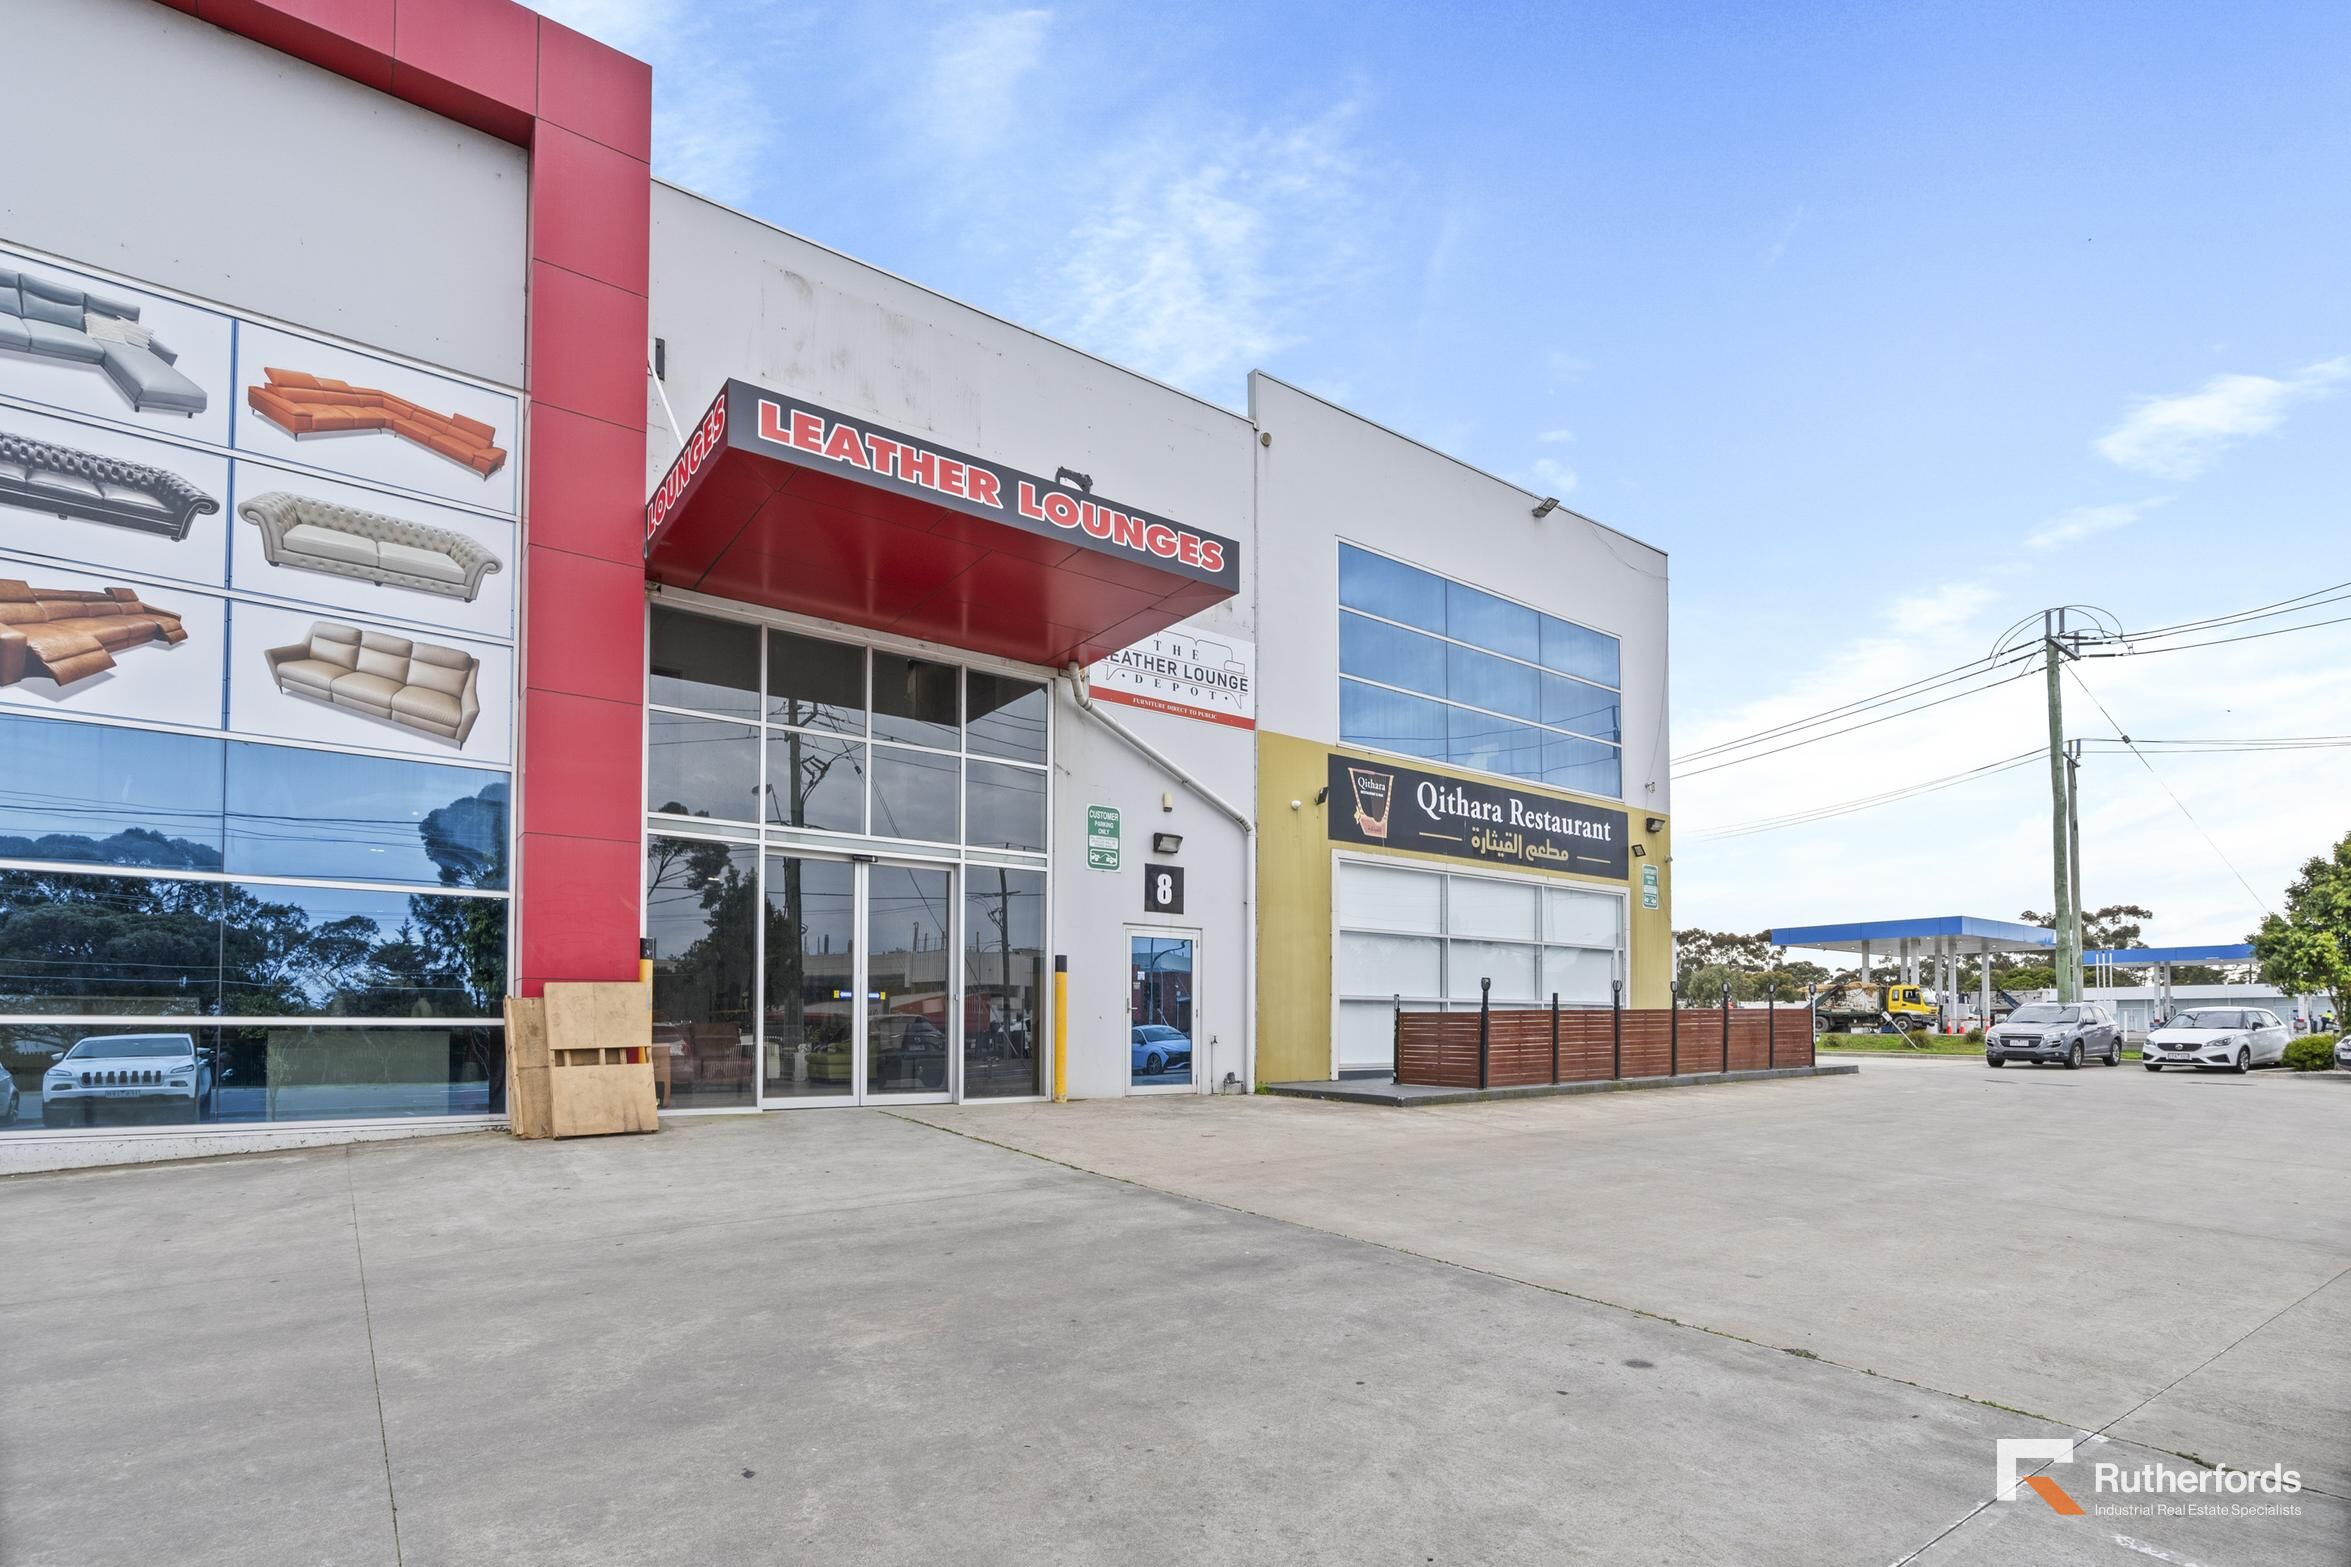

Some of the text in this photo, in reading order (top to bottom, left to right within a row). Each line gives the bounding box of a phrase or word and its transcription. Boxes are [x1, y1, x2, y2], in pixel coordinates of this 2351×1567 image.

[647, 394, 726, 540] LOUNGES
[757, 398, 1226, 574] LEATHER LOUNGES
[1153, 639, 1200, 660] THE
[1103, 650, 1249, 692] EATHER LOUNGE
[1135, 674, 1217, 700] DEPOT
[1132, 697, 1166, 709] FURNITURE
[1167, 704, 1188, 714] DIRECT
[1198, 710, 1217, 720] PUBLIC
[1357, 776, 1386, 791] Qithara
[1089, 810, 1119, 821] CUSTOMER
[1094, 820, 1114, 829] PARKING
[1416, 781, 1612, 842] Qithara Restaurant
[1471, 826, 1569, 861] مطعم القيثارة
[1157, 873, 1173, 905] 8
